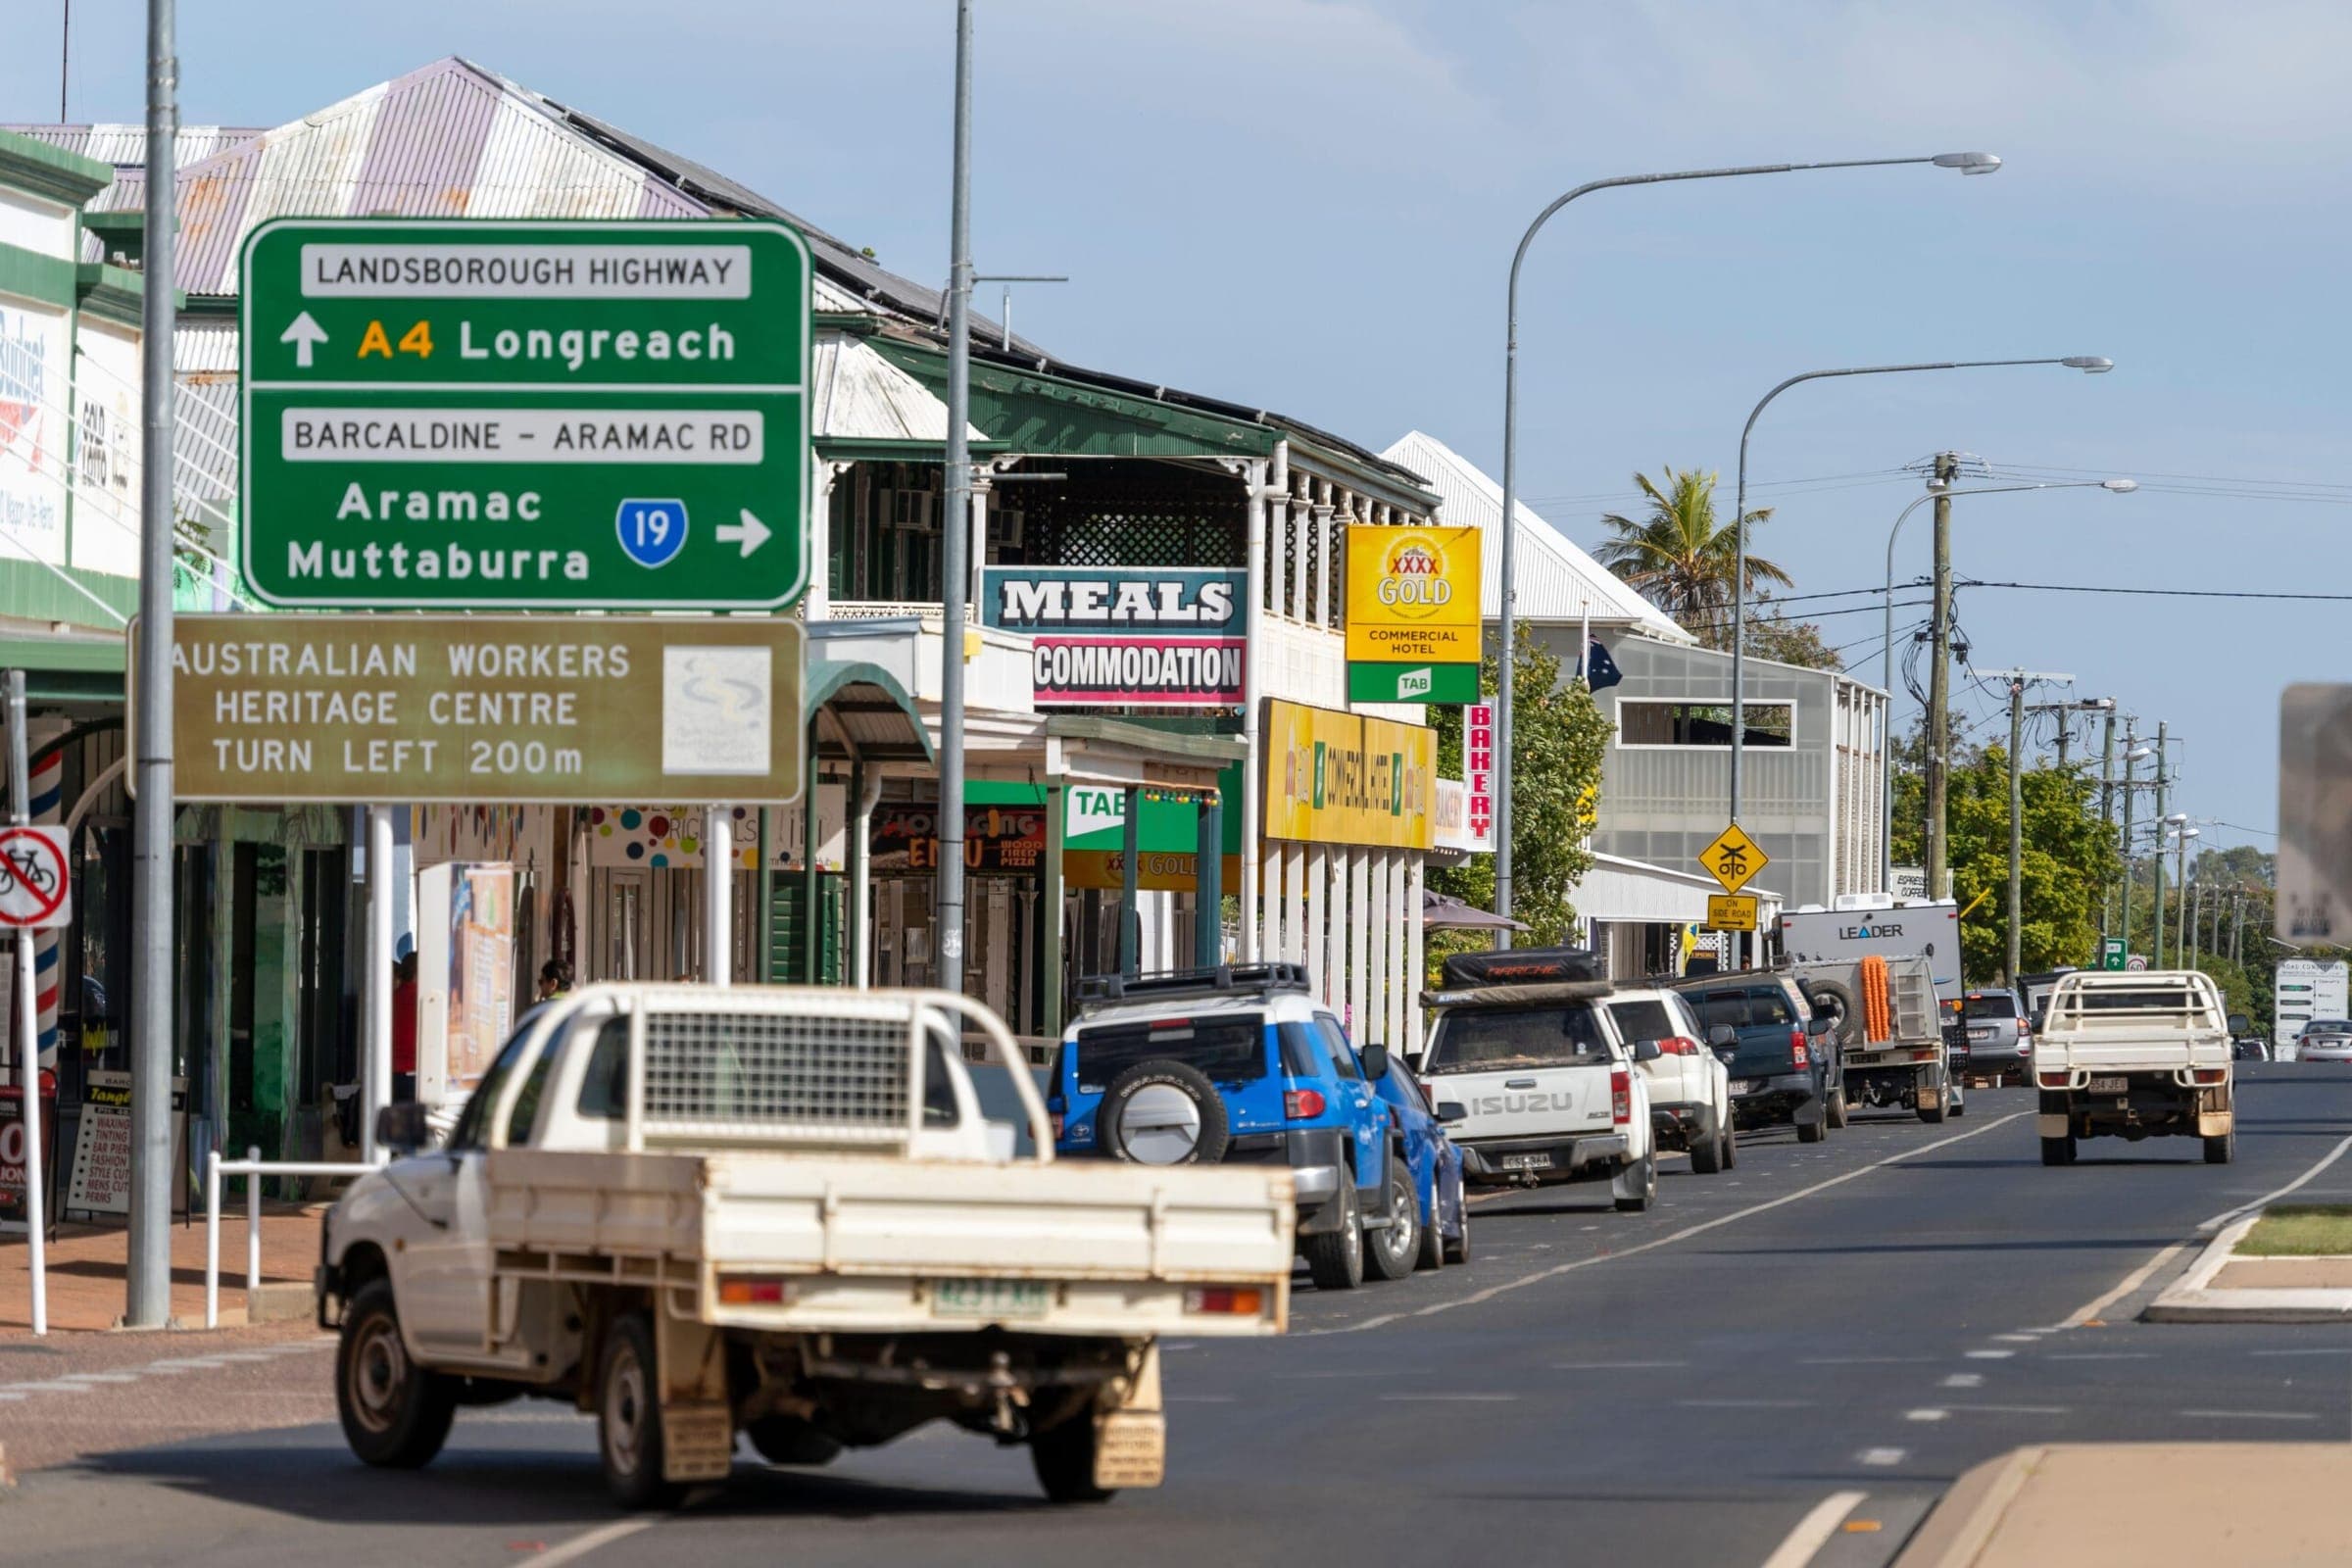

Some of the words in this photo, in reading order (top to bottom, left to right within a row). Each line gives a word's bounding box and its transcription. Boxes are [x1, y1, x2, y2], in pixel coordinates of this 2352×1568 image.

[317, 257, 575, 286] LANDSBOROUGH
[588, 257, 734, 286] HIGHWAY
[357, 319, 434, 360] A4
[460, 320, 736, 370] Longreach
[294, 421, 501, 451] BARCALDINE
[553, 421, 695, 451] ARAMAC
[709, 421, 753, 451] RD
[336, 483, 543, 521] Aramac
[633, 510, 670, 545] 19
[287, 540, 591, 581] Muttaburra
[1391, 557, 1439, 574] XXXX
[1000, 579, 1235, 628] MEALS
[1377, 577, 1452, 606] GOLD
[1369, 630, 1458, 642] COMMERCIAL
[1392, 643, 1436, 655] HOTEL
[172, 643, 417, 678] AUSTRALIAN
[448, 644, 631, 678] WORKERS
[1401, 677, 1428, 690] TAB
[215, 692, 398, 725] HERITAGE
[428, 692, 578, 725] CENTRE
[213, 740, 314, 774] TURN
[344, 740, 439, 774] LEFT
[470, 740, 582, 774] 200m
[1470, 706, 1493, 840] BAKERY
[1726, 900, 1739, 908] ON
[1732, 909, 1752, 918] ROAD
[1472, 1092, 1573, 1116] ISUZU
